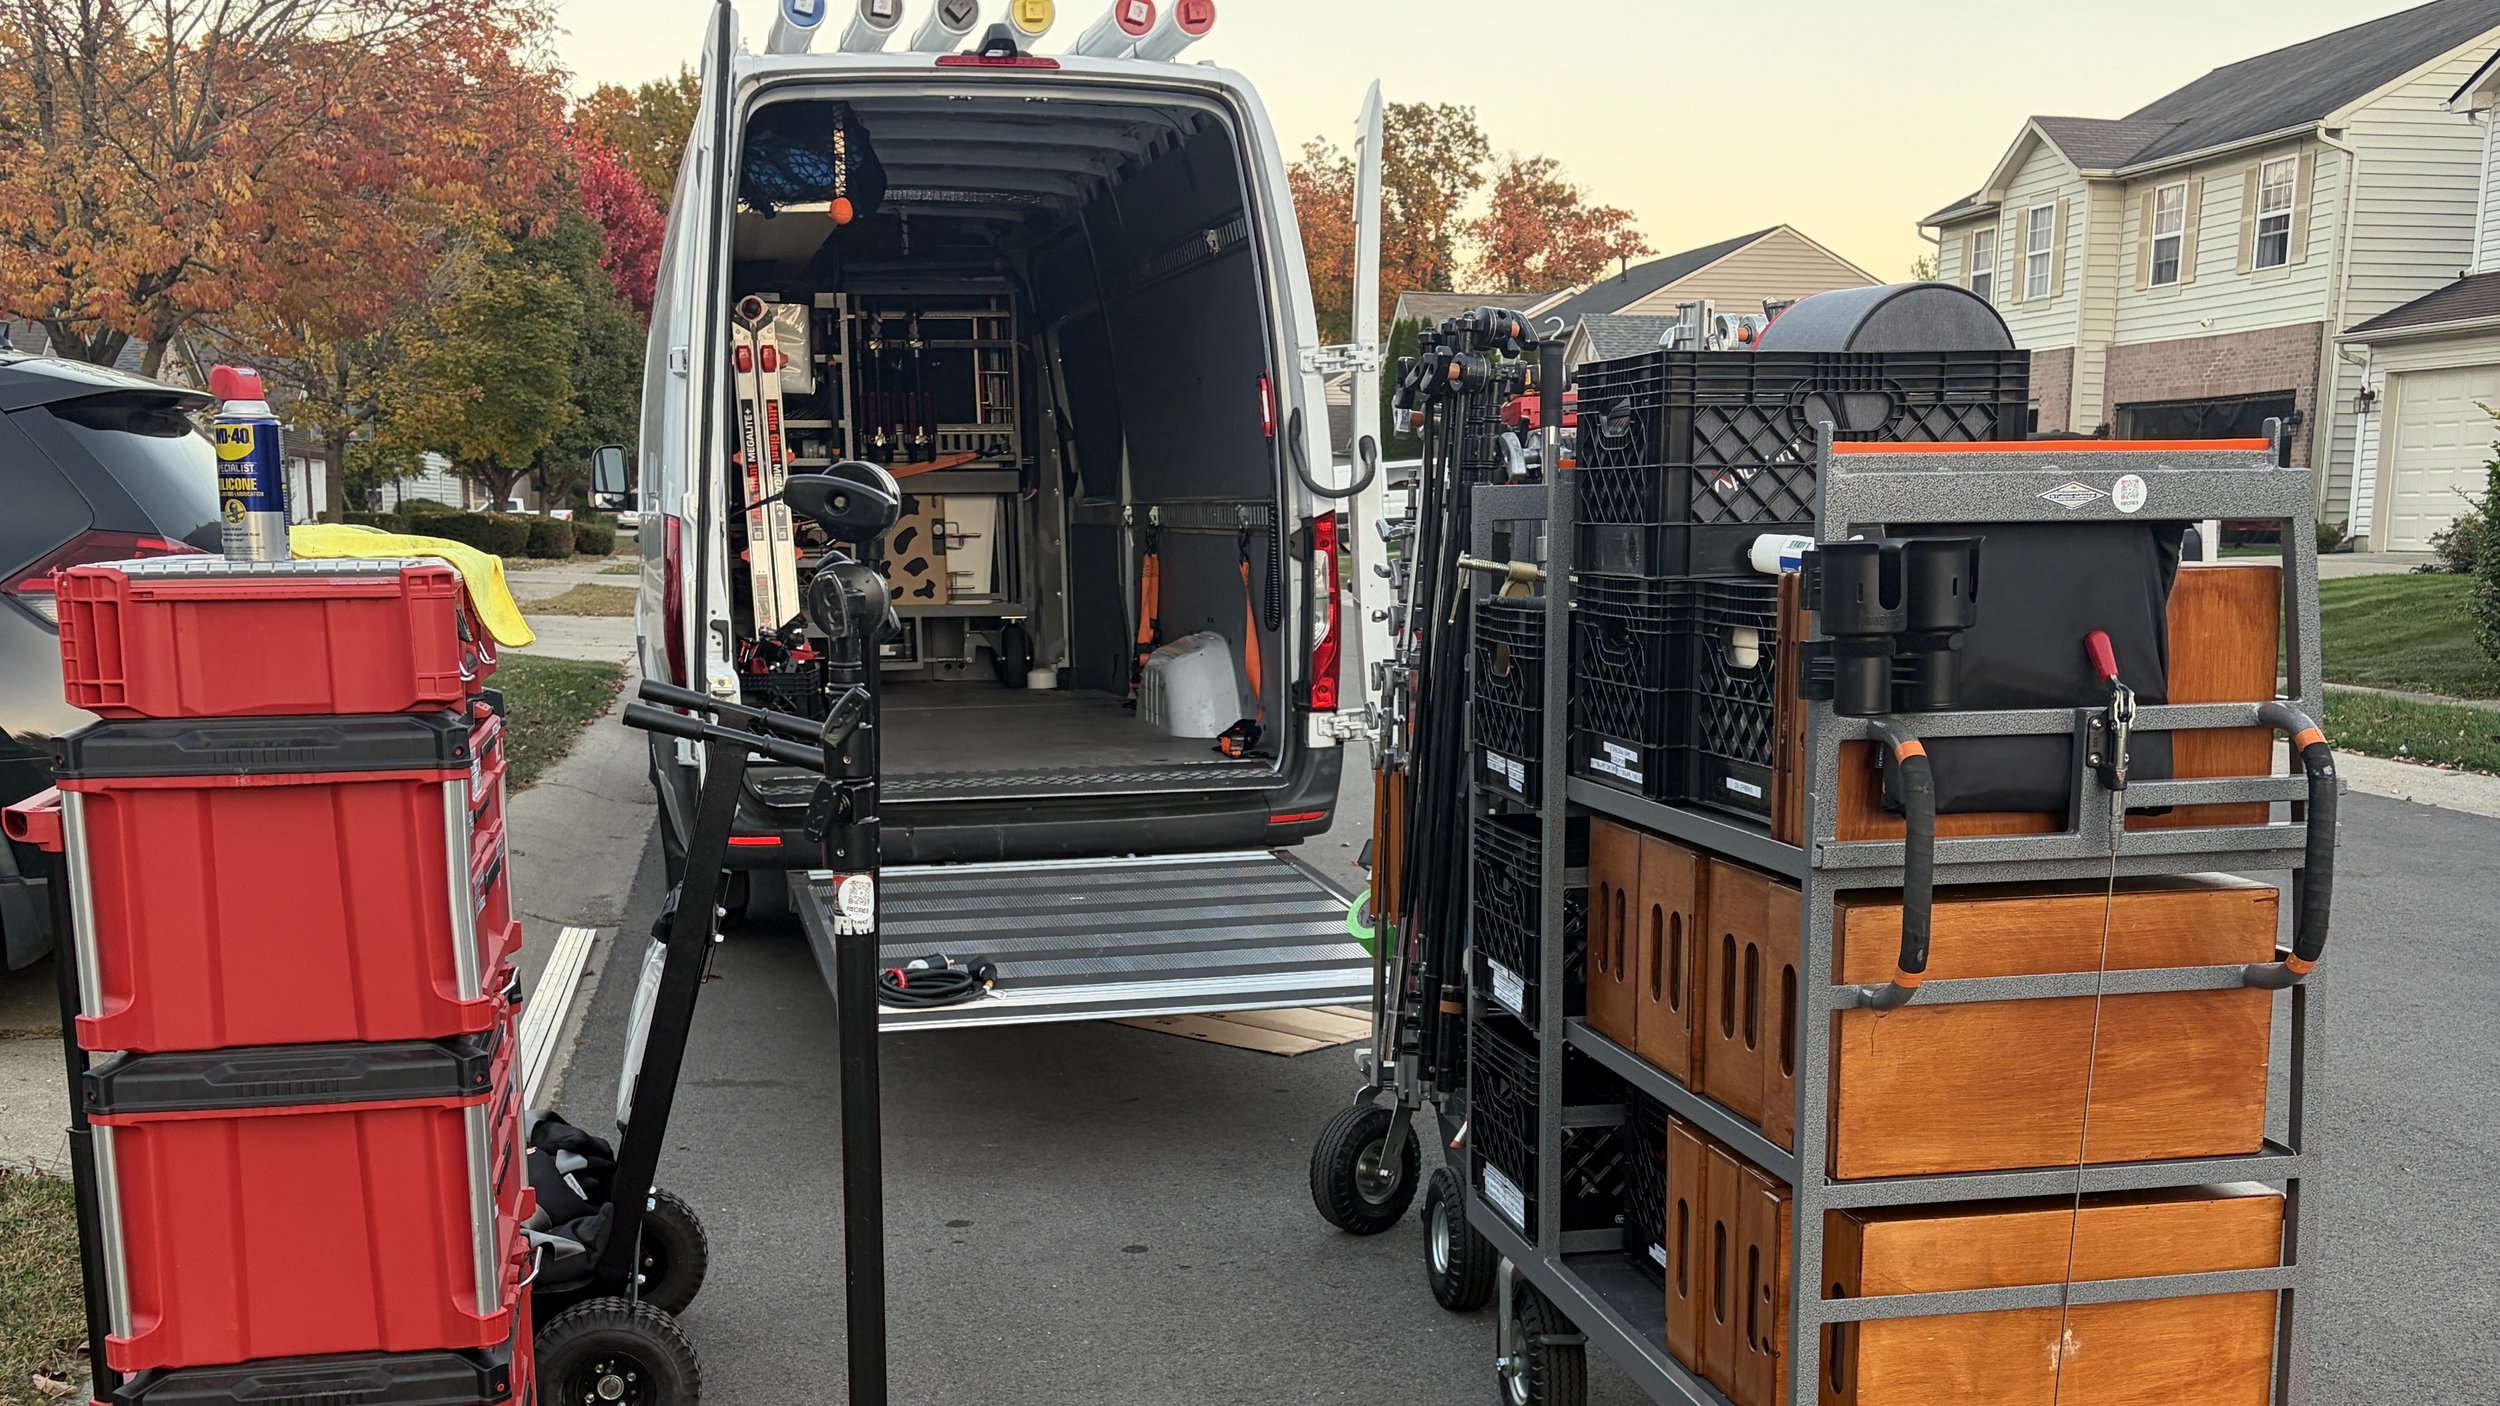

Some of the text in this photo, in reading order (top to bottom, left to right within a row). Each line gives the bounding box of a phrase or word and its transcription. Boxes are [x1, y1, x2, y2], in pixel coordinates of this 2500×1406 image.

[767, 402, 778, 431] Little
[744, 408, 756, 462] MEGALITE+
[769, 434, 781, 463] Giant
[217, 463, 255, 473] PECIALIST
[219, 477, 258, 491] ILICONE
[772, 464, 785, 516] MEGATE+
